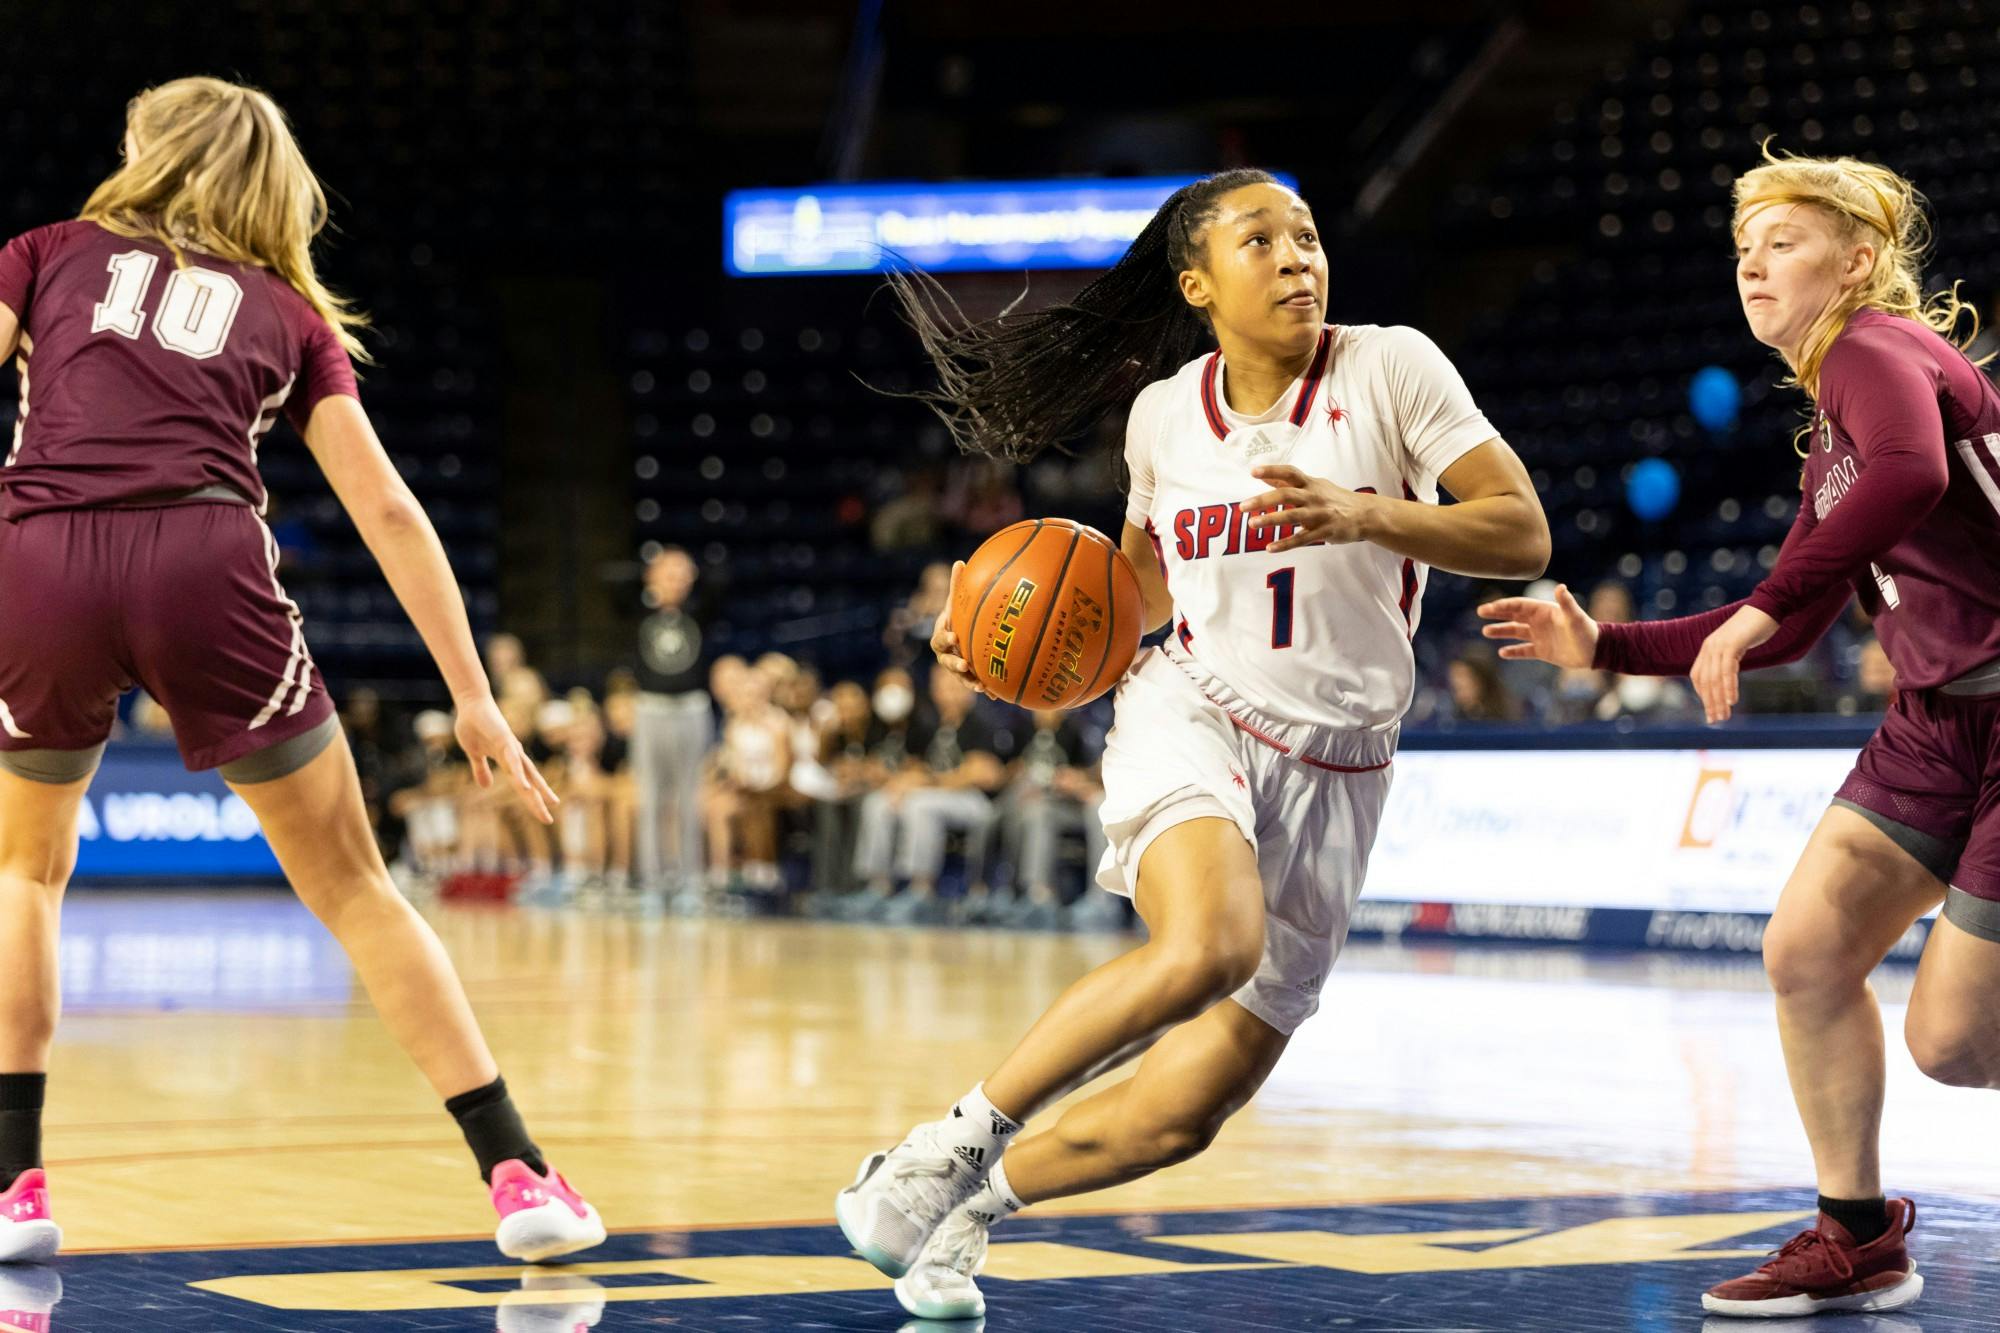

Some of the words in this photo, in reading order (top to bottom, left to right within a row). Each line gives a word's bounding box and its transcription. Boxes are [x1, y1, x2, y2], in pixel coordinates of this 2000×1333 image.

[91, 249, 244, 360] 10
[1174, 486, 1378, 561] SPID
[989, 577, 1038, 682] ELITE
[1266, 567, 1295, 649] 1
[1037, 611, 1067, 687] PERFECTION
[104, 792, 265, 842] UROLO
